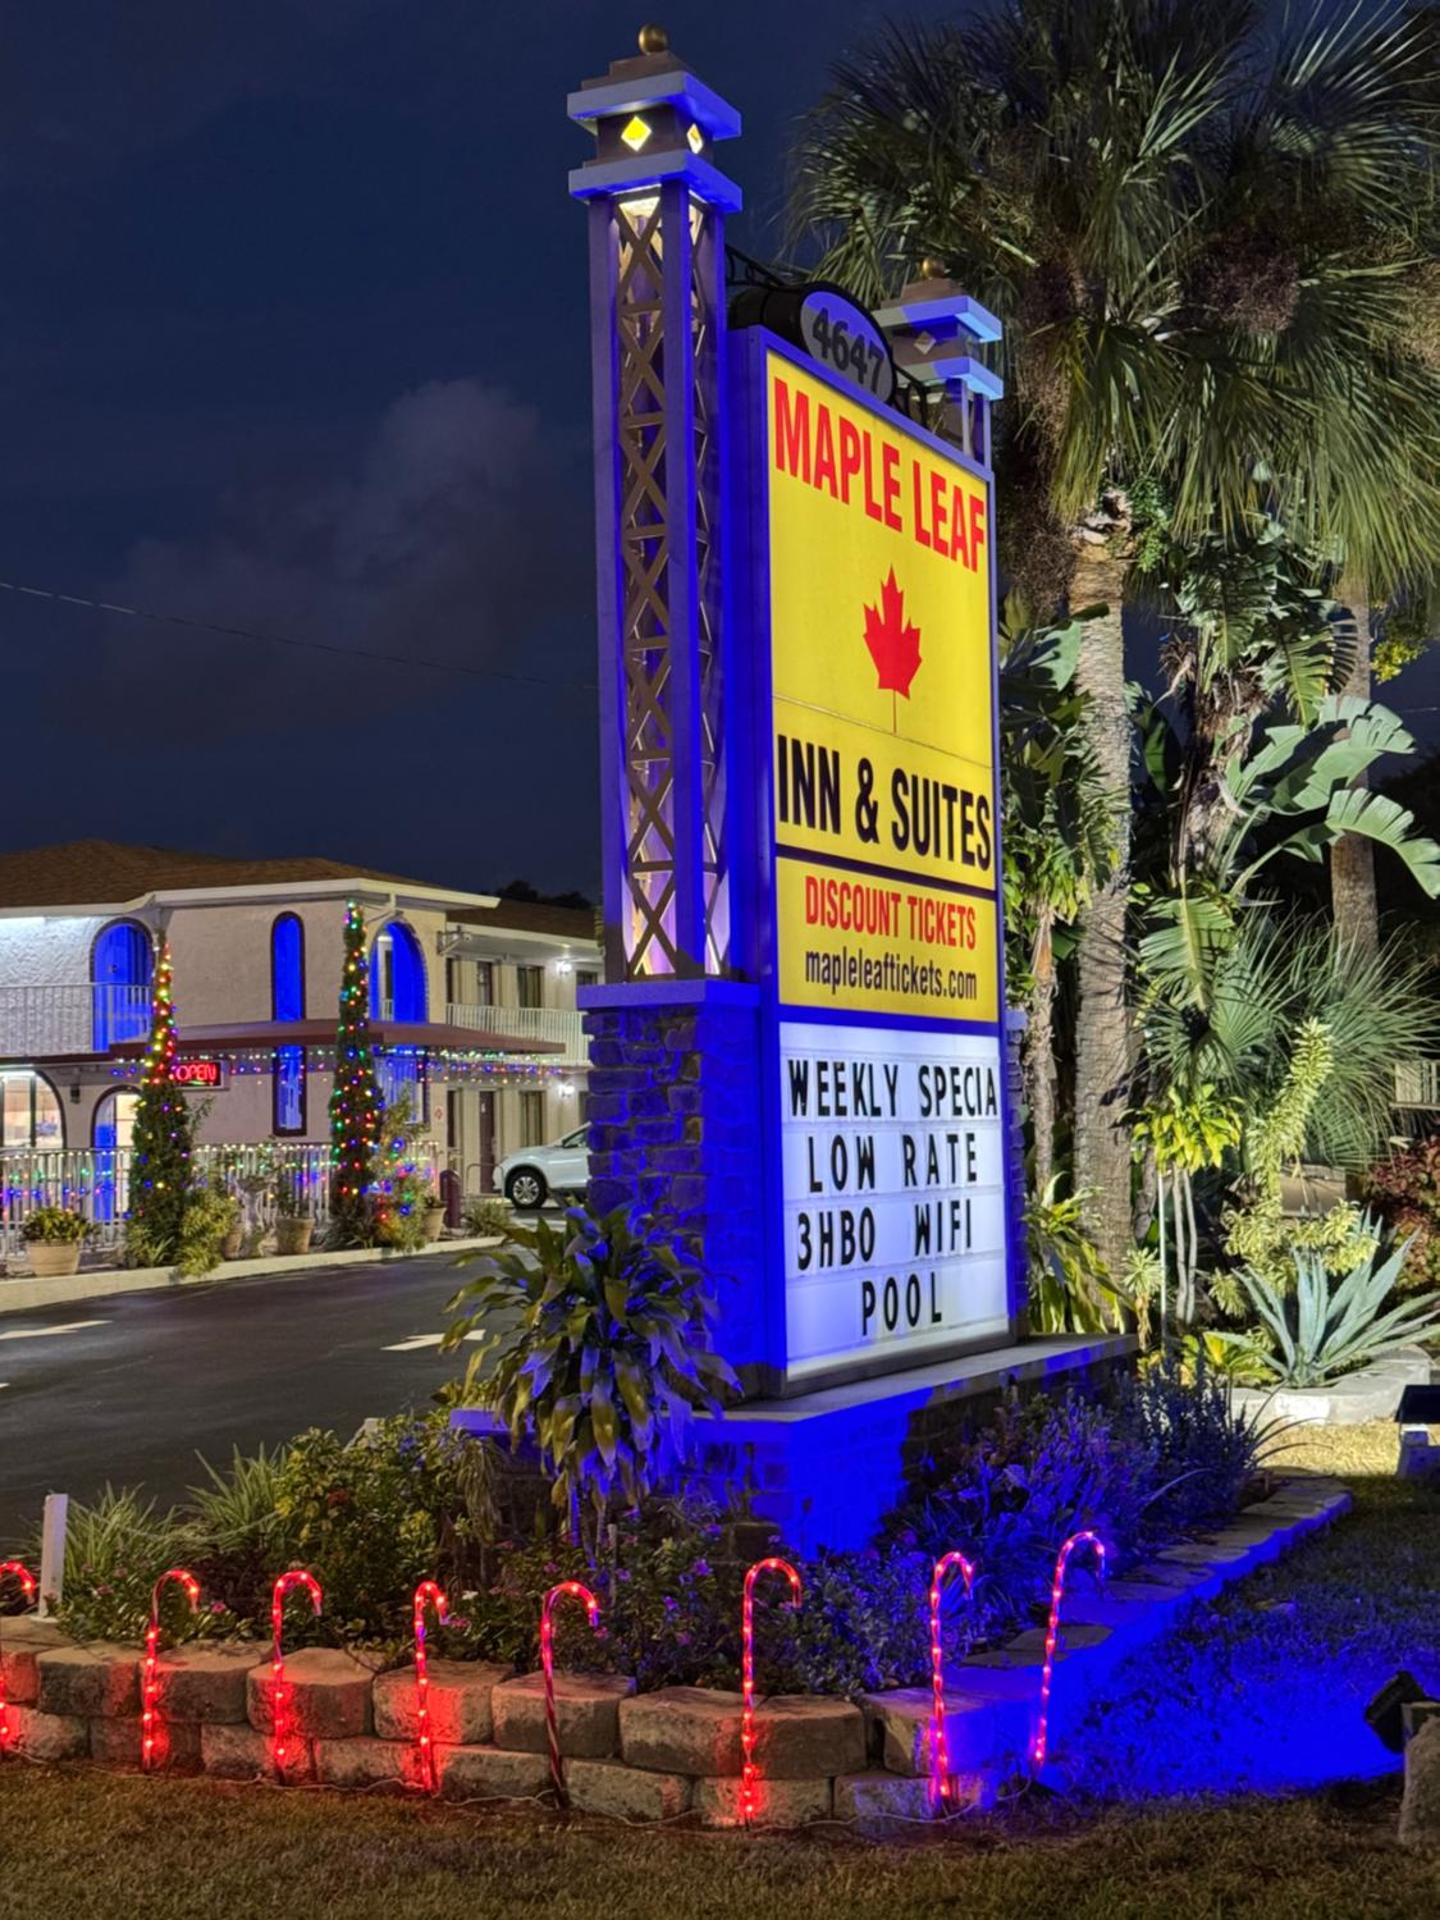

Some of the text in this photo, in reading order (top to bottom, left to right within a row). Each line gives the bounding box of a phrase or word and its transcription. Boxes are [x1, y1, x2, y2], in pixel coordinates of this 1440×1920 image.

[812, 306, 885, 393] 4647
[774, 377, 985, 573] MAPLE LEAF
[777, 734, 992, 872] INN & SUITES
[804, 875, 976, 951] DISCOUNT TICKETS
[805, 946, 977, 1001] mapleleaftickets.com
[175, 1063, 217, 1081] OPEN
[788, 1060, 998, 1117] WEEKLY SPECIA
[808, 1133, 977, 1193] LOW RATE
[797, 1199, 972, 1270] 3HBO WIFI
[862, 1272, 943, 1336] POOL
